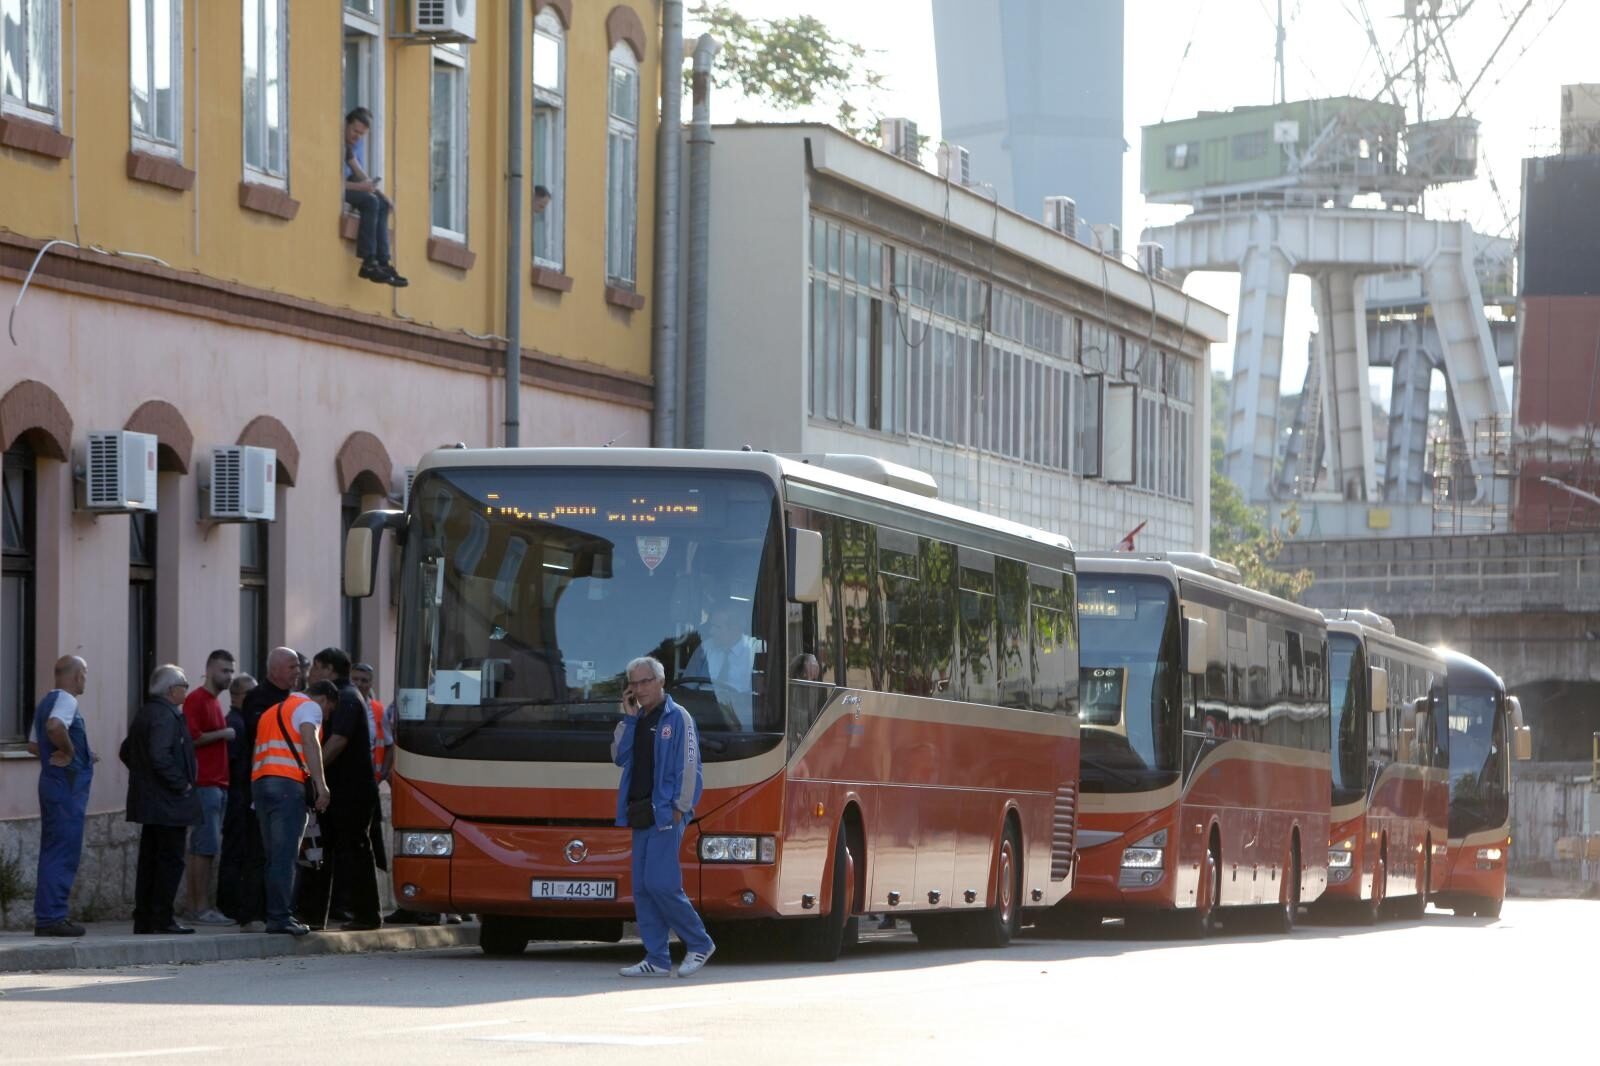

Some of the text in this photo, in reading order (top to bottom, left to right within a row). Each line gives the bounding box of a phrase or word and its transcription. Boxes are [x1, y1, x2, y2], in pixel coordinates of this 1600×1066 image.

[450, 681, 460, 699] 1
[541, 882, 612, 897] RI 443-UM
